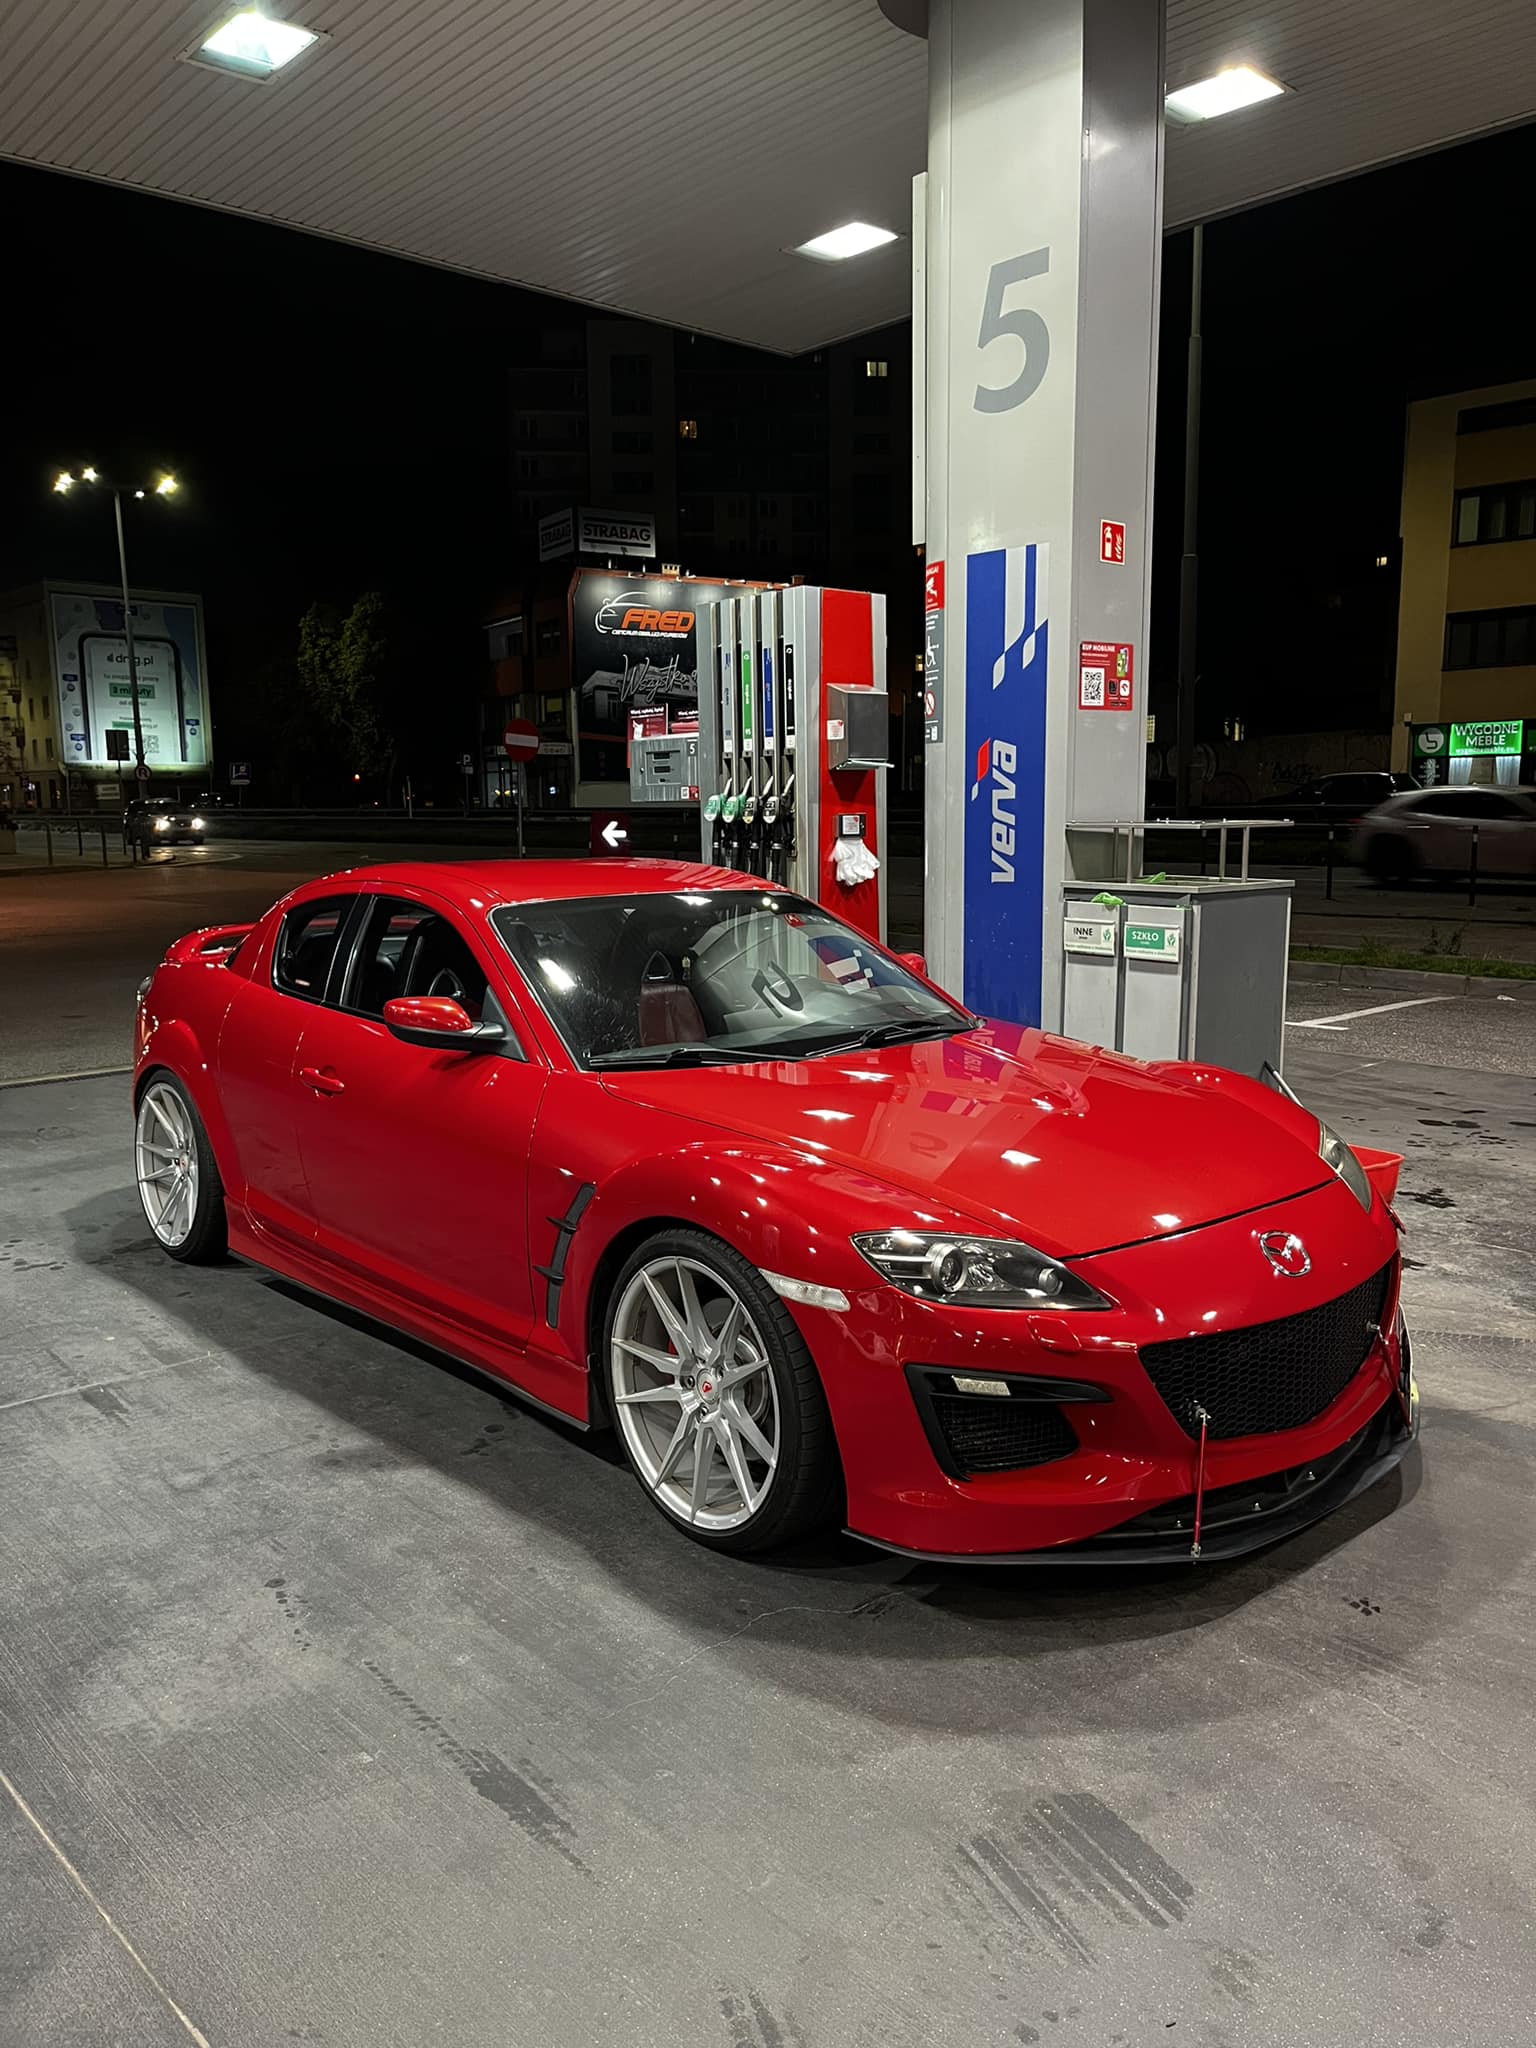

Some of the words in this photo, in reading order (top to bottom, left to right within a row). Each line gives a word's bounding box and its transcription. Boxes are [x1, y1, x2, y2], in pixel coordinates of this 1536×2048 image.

[973, 246, 1049, 413] 5
[583, 523, 651, 541] STRABAG
[622, 608, 695, 632] FRED
[115, 654, 153, 666] drg.pl
[120, 686, 151, 696] miuty
[1455, 724, 1519, 736] WYGODNE
[1465, 735, 1506, 747] MEBLE
[689, 743, 695, 754] 5
[463, 754, 471, 765] P
[991, 740, 1016, 883] verva
[1073, 927, 1093, 936] INNE
[1131, 930, 1159, 941] SZKŁO
